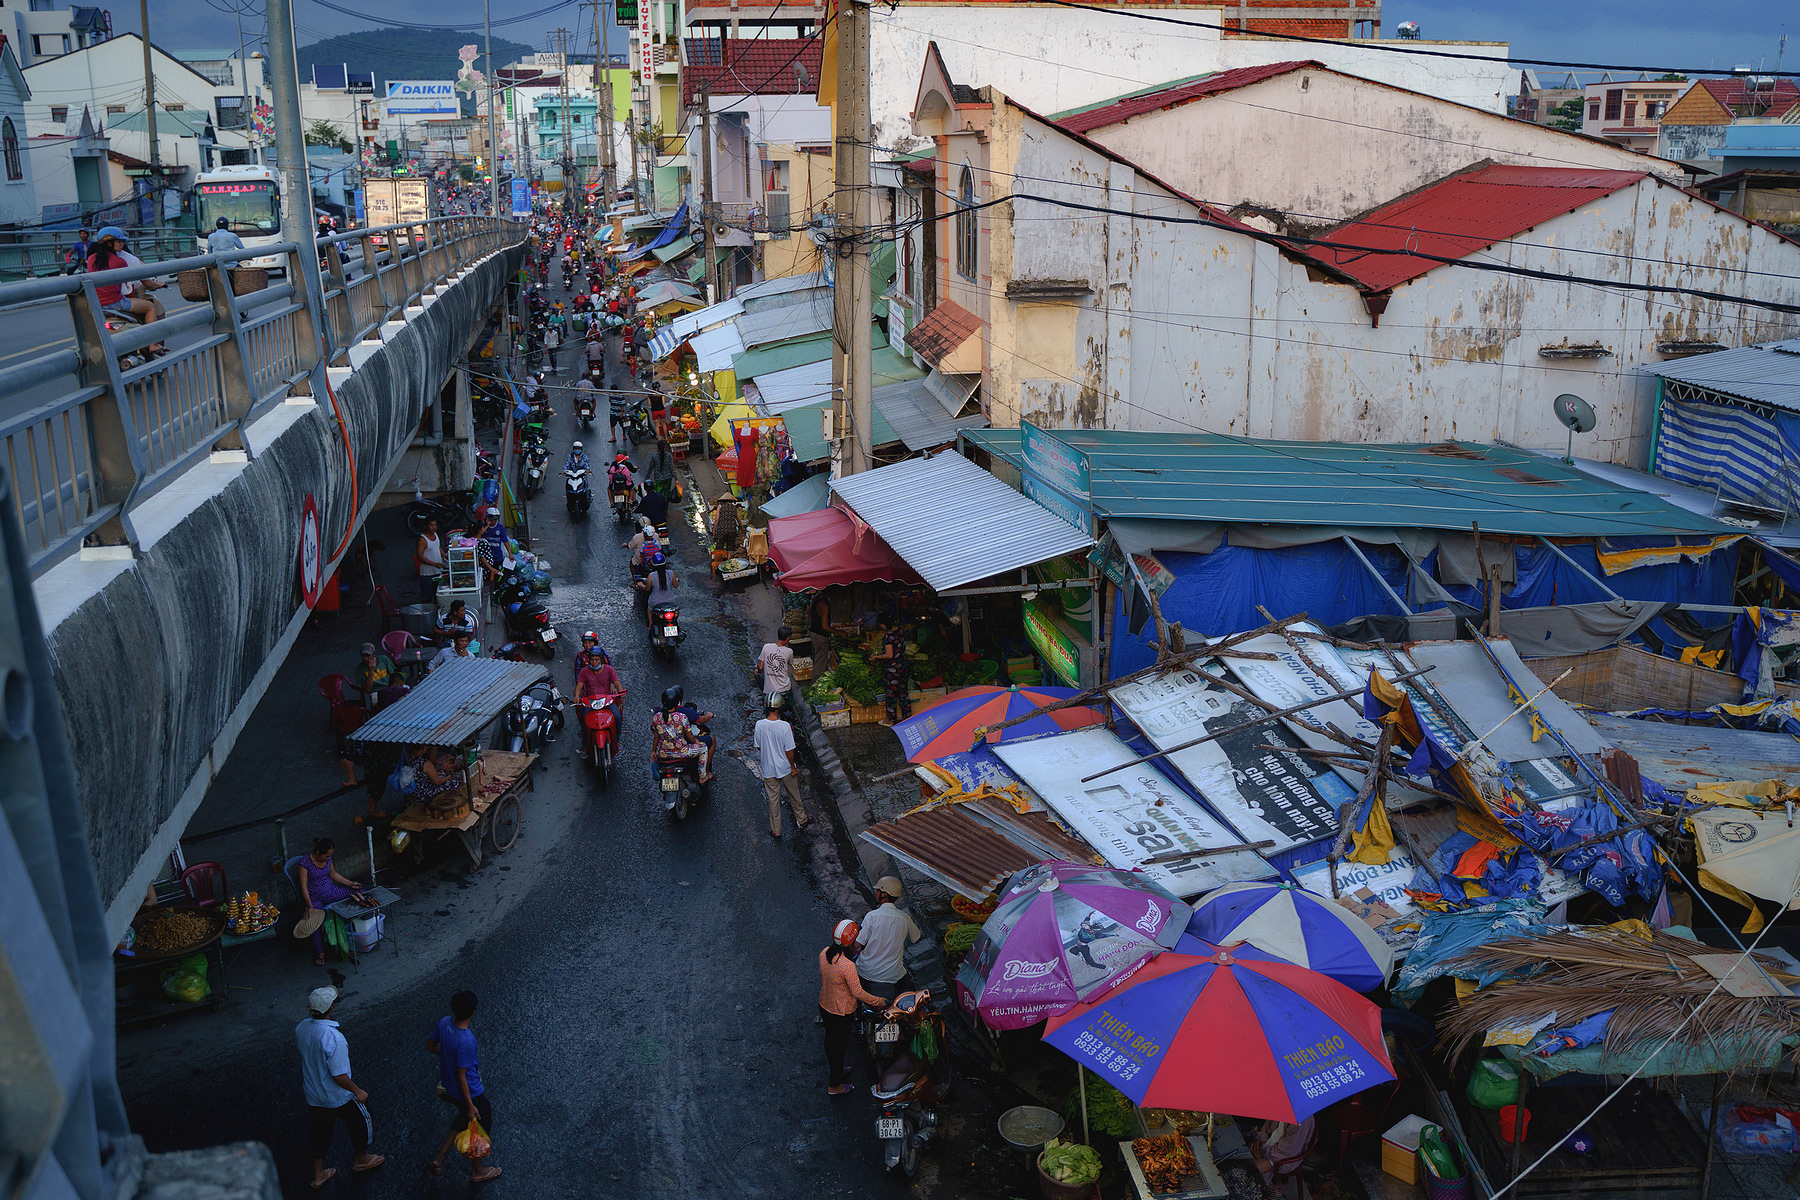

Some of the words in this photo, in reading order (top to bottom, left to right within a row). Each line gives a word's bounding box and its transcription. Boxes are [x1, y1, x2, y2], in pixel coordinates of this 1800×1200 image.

[402, 86, 452, 94] DAIKIN
[1029, 437, 1046, 456] BA
[1106, 568, 1122, 584] 0939
[1302, 676, 1329, 697] CHO
[1260, 754, 1286, 776] Nạp
[1244, 767, 1269, 786] cho
[1263, 785, 1292, 810] hôm
[1286, 808, 1320, 832] nay!
[1084, 784, 1210, 874] Dsani
[1606, 884, 1622, 902] 192
[1136, 899, 1162, 934] Diana
[1004, 957, 1059, 980] Diana
[987, 980, 1001, 995] Là
[1012, 984, 1029, 999] gái
[1097, 1010, 1135, 1042] THIÊN
[1130, 1035, 1160, 1057] BẢO
[1074, 1037, 1097, 1056] 0933
[1095, 1052, 1109, 1064] 55
[1108, 1061, 1121, 1072] 69
[1119, 1070, 1133, 1081] 24
[1080, 1031, 1103, 1049] 0913
[1102, 1046, 1115, 1058] 81
[1114, 1055, 1128, 1066] 88
[1126, 1063, 1141, 1074] 24
[1283, 1046, 1320, 1069] THIÊN
[1315, 1034, 1345, 1057] BẢO
[1300, 1075, 1323, 1090] 0913
[1322, 1070, 1335, 1081] 81
[1334, 1065, 1347, 1076] 88
[1346, 1059, 1359, 1071] 24
[1306, 1084, 1329, 1099] 0933
[1328, 1078, 1341, 1089] 55
[1340, 1073, 1353, 1084] 69
[1352, 1068, 1365, 1079] 24
